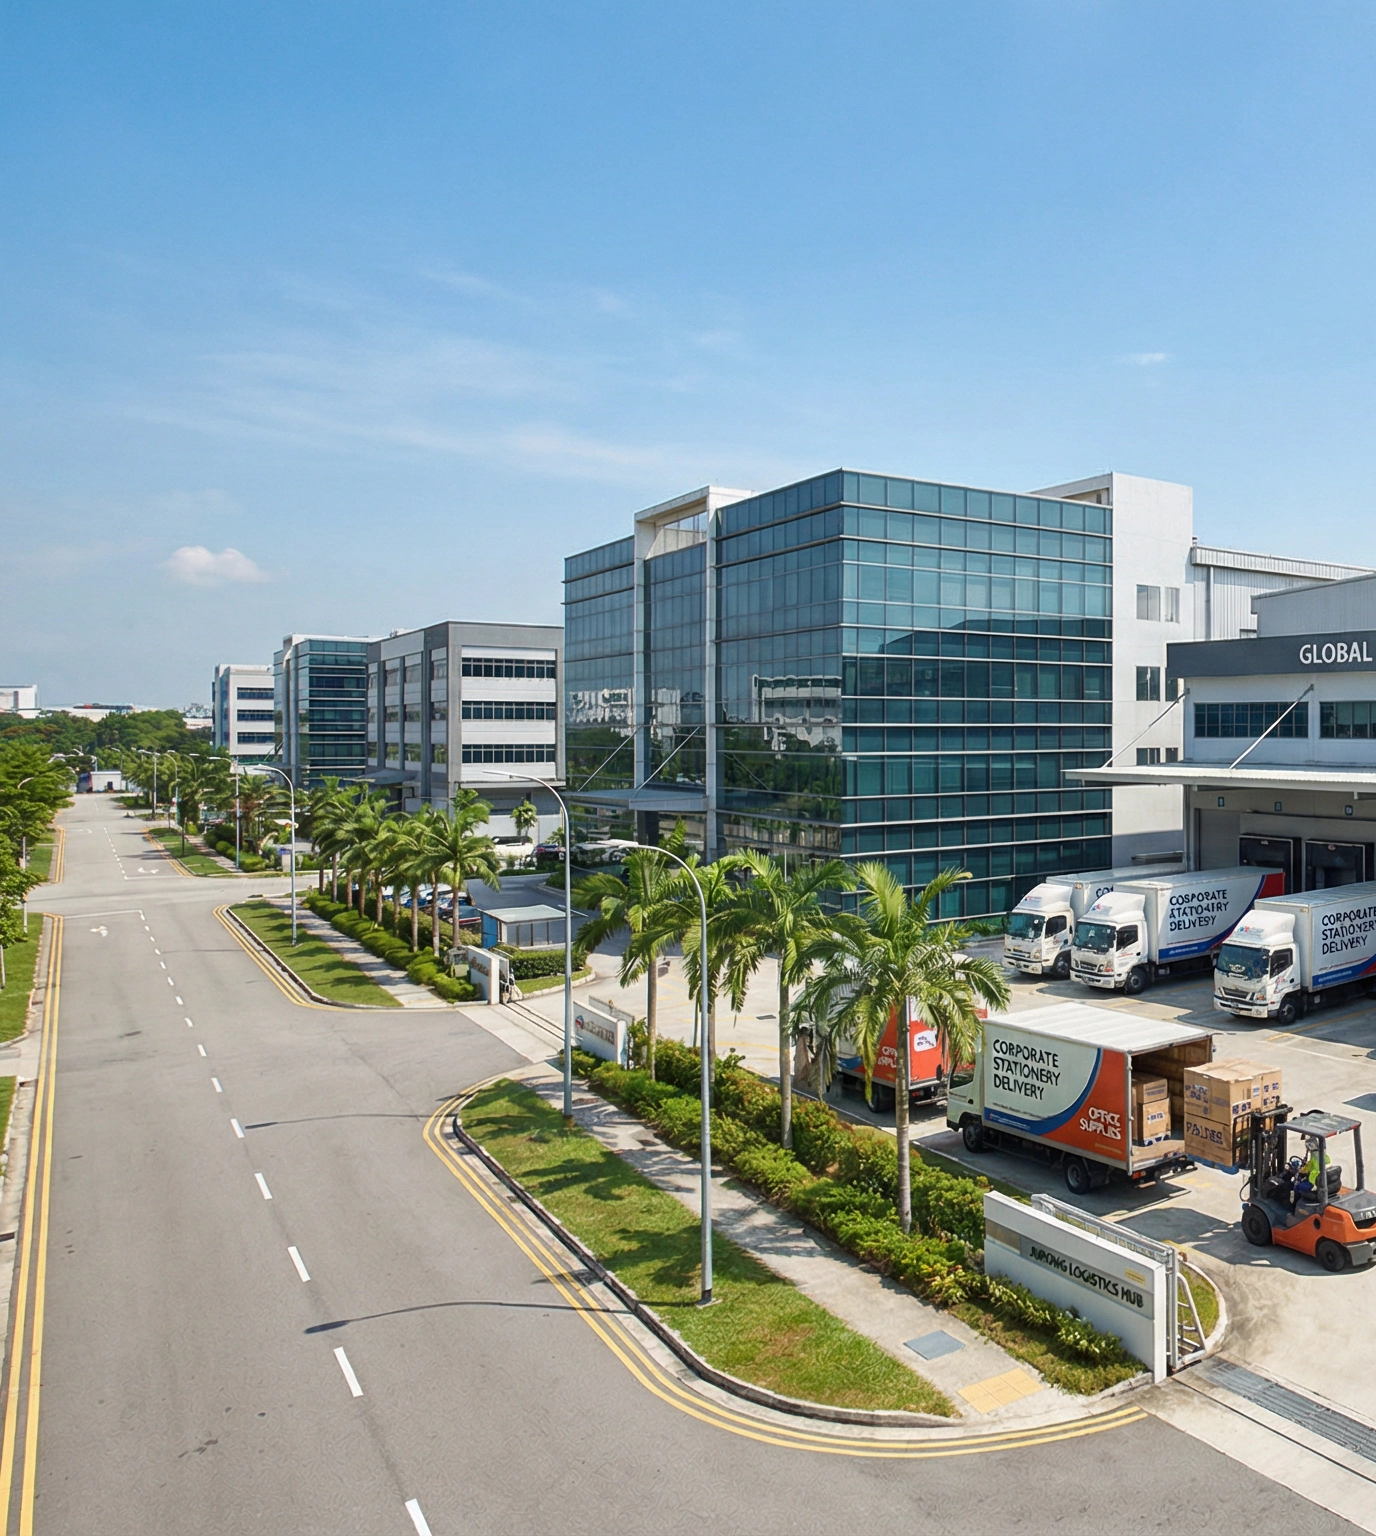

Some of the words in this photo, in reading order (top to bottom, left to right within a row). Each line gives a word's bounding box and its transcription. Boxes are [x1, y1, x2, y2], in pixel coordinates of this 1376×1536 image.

[1300, 641, 1373, 665] GLOBAL
[993, 1039, 1059, 1069] CORPORATE
[993, 1056, 1061, 1087] STATIONERY
[994, 1074, 1045, 1101] DELIVERY
